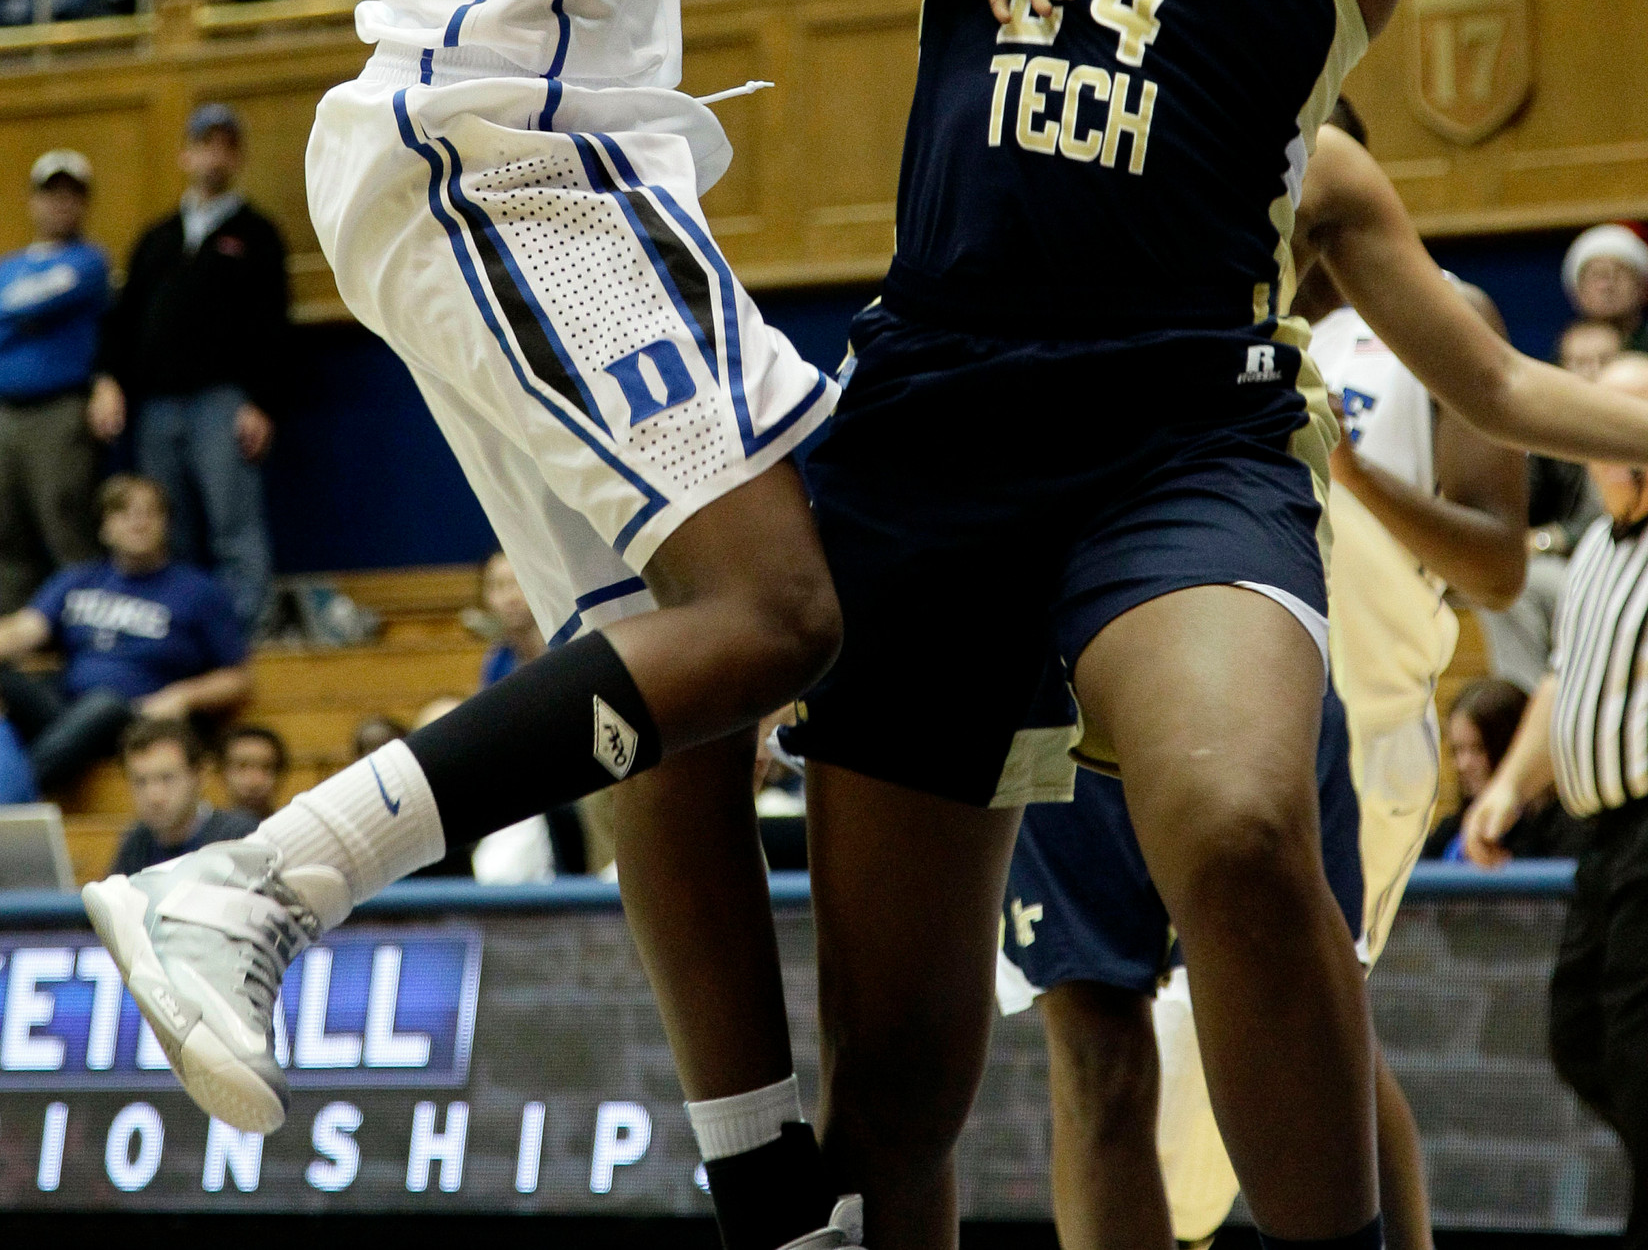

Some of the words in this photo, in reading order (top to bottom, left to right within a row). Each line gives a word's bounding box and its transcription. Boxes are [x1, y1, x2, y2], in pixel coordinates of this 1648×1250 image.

[1430, 16, 1502, 104] 17
[987, 53, 1158, 176] TECH
[603, 339, 697, 428] D
[37, 1101, 711, 1194] IONSHIP
